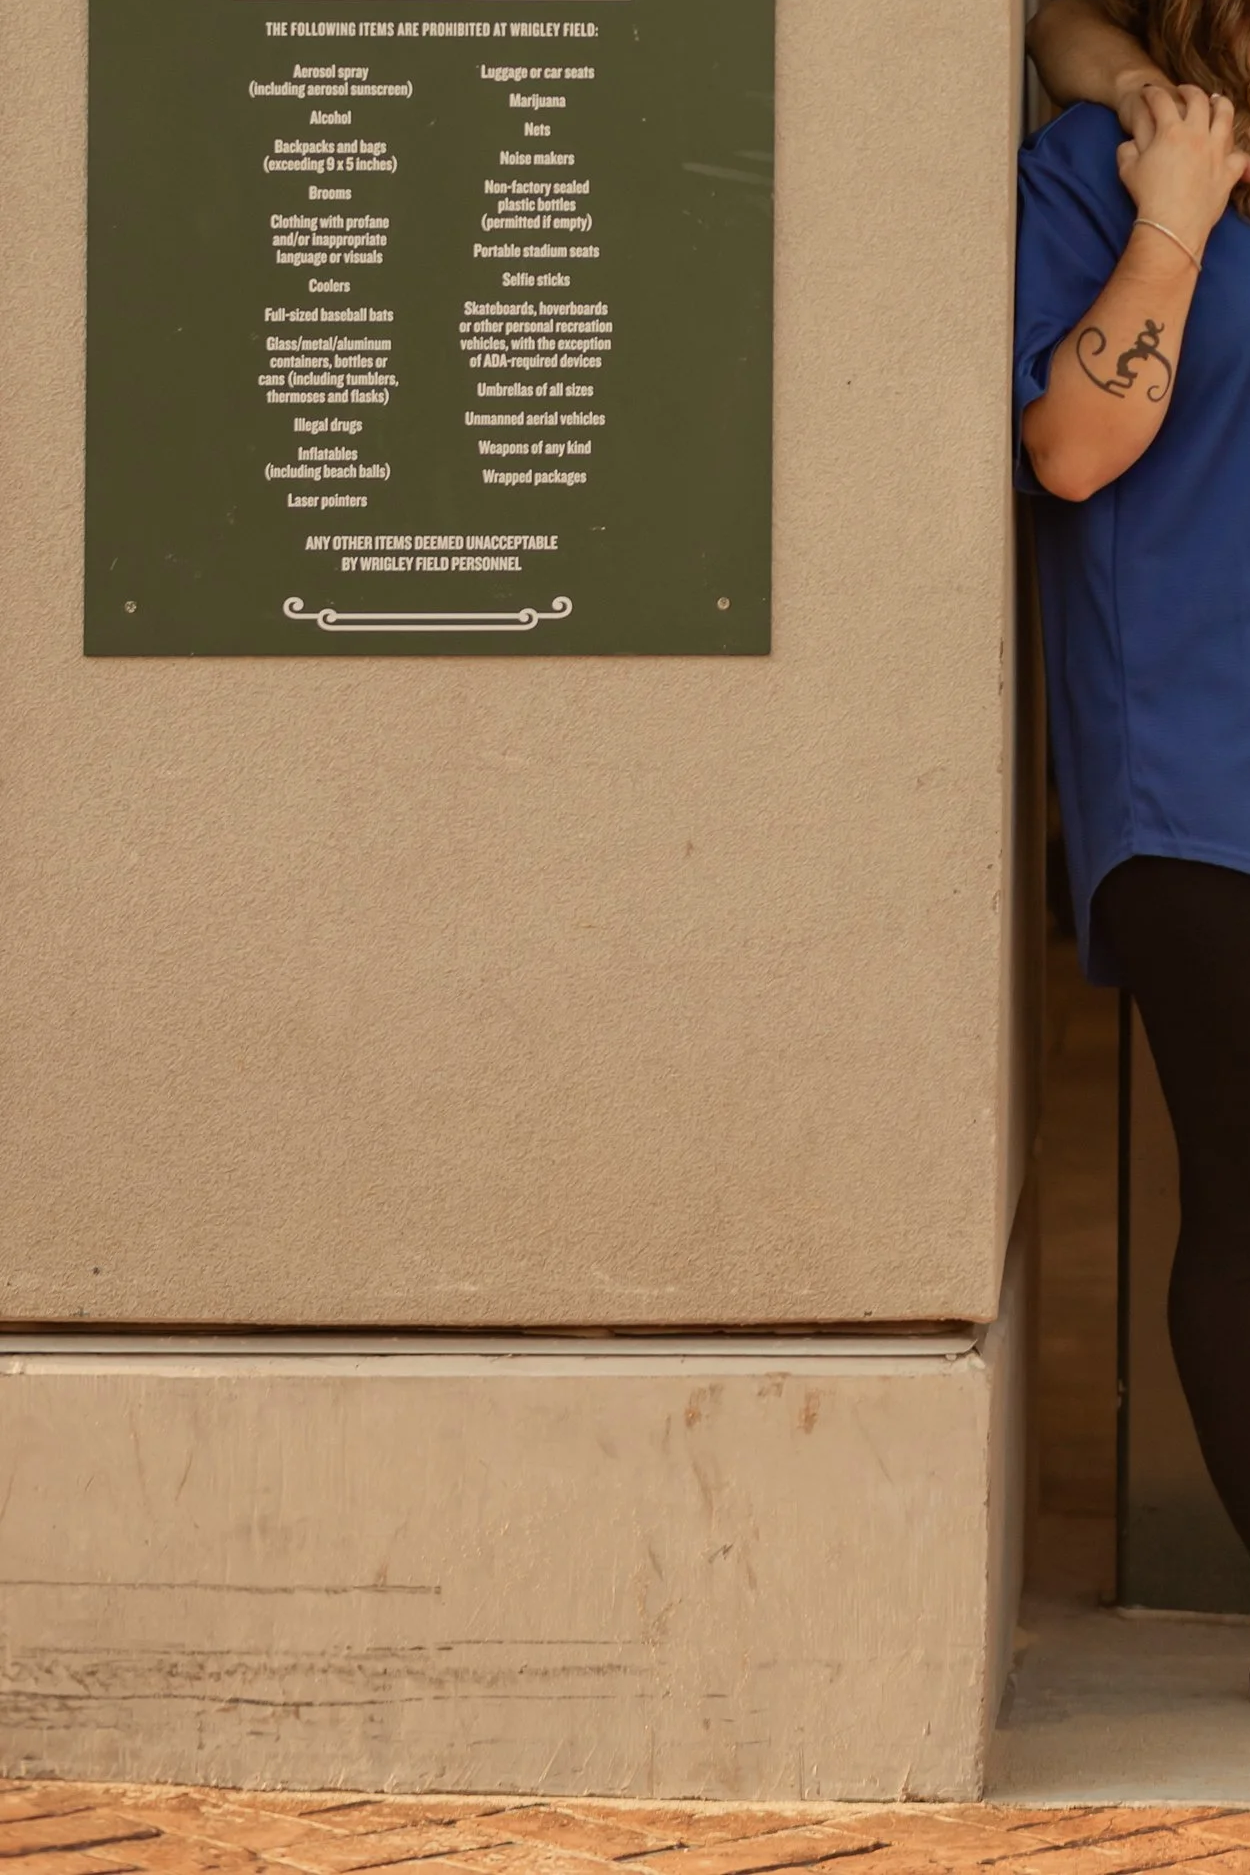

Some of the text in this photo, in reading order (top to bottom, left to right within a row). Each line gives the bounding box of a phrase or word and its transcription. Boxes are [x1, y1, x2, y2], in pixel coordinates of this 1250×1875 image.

[266, 22, 598, 37] THE FOLLOWING ITEMS ARE PROHIBITED AT WRIGLEY FIELD:
[293, 64, 368, 81] Aerosol spray
[481, 65, 594, 81] Luggage or car seats
[249, 80, 412, 98] (including aerosol sunscreen)
[510, 93, 566, 110] Marijuana
[310, 111, 351, 124] Alcohol
[524, 122, 550, 136] Nets
[275, 139, 386, 156] Backpacks and bags
[264, 155, 397, 173] (exceeding 9 x 5 inches)
[500, 151, 574, 165] Noise makers
[309, 186, 352, 199] Brooms
[485, 180, 589, 196] Non-factory sealed
[498, 197, 576, 214] plastic bottles
[271, 215, 389, 232] Clothing with profane
[482, 213, 592, 231] (permitted if empty)
[272, 231, 387, 249] and/or inappropriate
[276, 250, 382, 266] language or visuals
[474, 244, 599, 257] Portable stadium seats
[309, 279, 350, 292] Coolers
[502, 273, 570, 286] Selfie sticks
[265, 308, 393, 321] Full-sized baseball bats
[464, 301, 608, 316] Skateboards, hoverboards
[459, 319, 612, 335] or other personal recreation
[266, 336, 391, 351] Glass/metal/aluminum
[460, 336, 611, 353] vehicles, with the exception
[270, 354, 388, 372] containers, bottles or
[470, 354, 602, 370] of ADA-required devices
[258, 370, 398, 389] cans (including tumblers,
[266, 388, 389, 405] thermoses and flasks)
[478, 383, 593, 397] Umbrellas of all sizes
[294, 418, 362, 434] Illegal drugs
[465, 411, 605, 425] Unmanned aerial vehicles
[298, 447, 358, 461] Inflatables
[478, 441, 591, 457] Weapons of any kind
[265, 463, 390, 481] (including beach balls)
[483, 469, 586, 486] Wrapped packages
[288, 493, 367, 509] Laser pointers
[306, 536, 558, 550] ANY OTHER ITEMS DEEMED UNACCEPTABLE
[342, 557, 522, 571] BY WRIGLEY FIELD PERSONNEL
